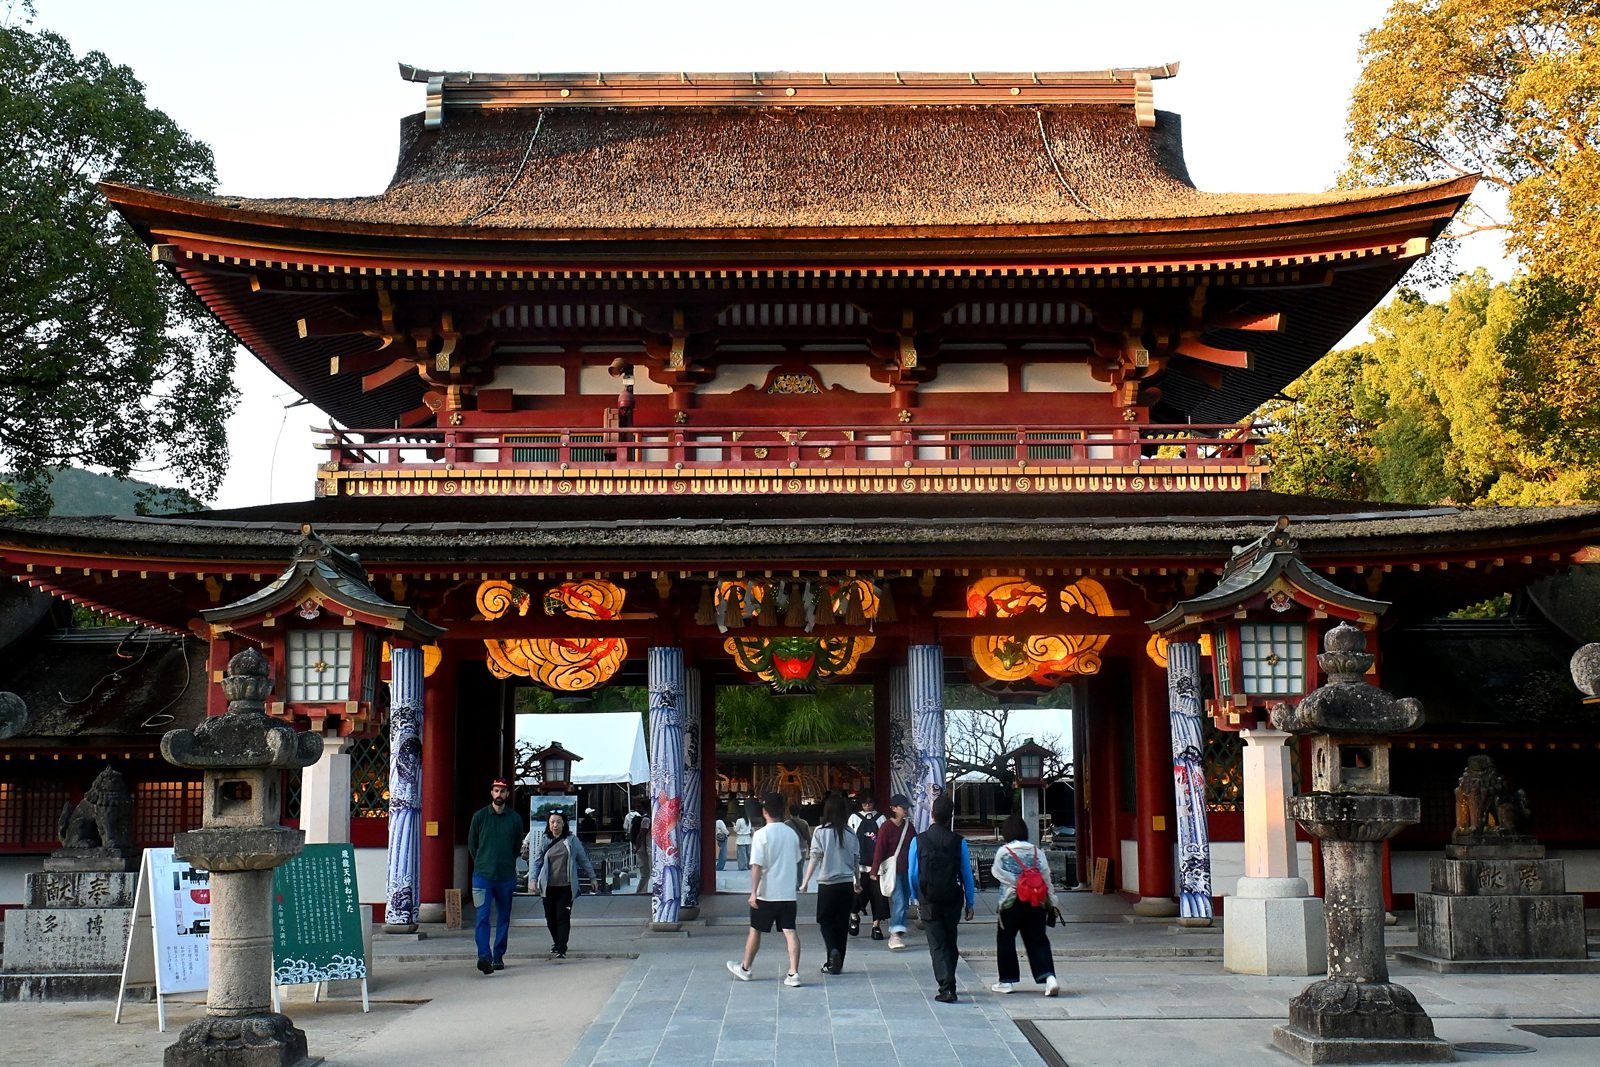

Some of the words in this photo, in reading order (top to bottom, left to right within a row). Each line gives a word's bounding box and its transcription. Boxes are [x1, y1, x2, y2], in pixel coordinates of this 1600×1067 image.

[341, 849, 354, 913] 飛龍天神ねぶた
